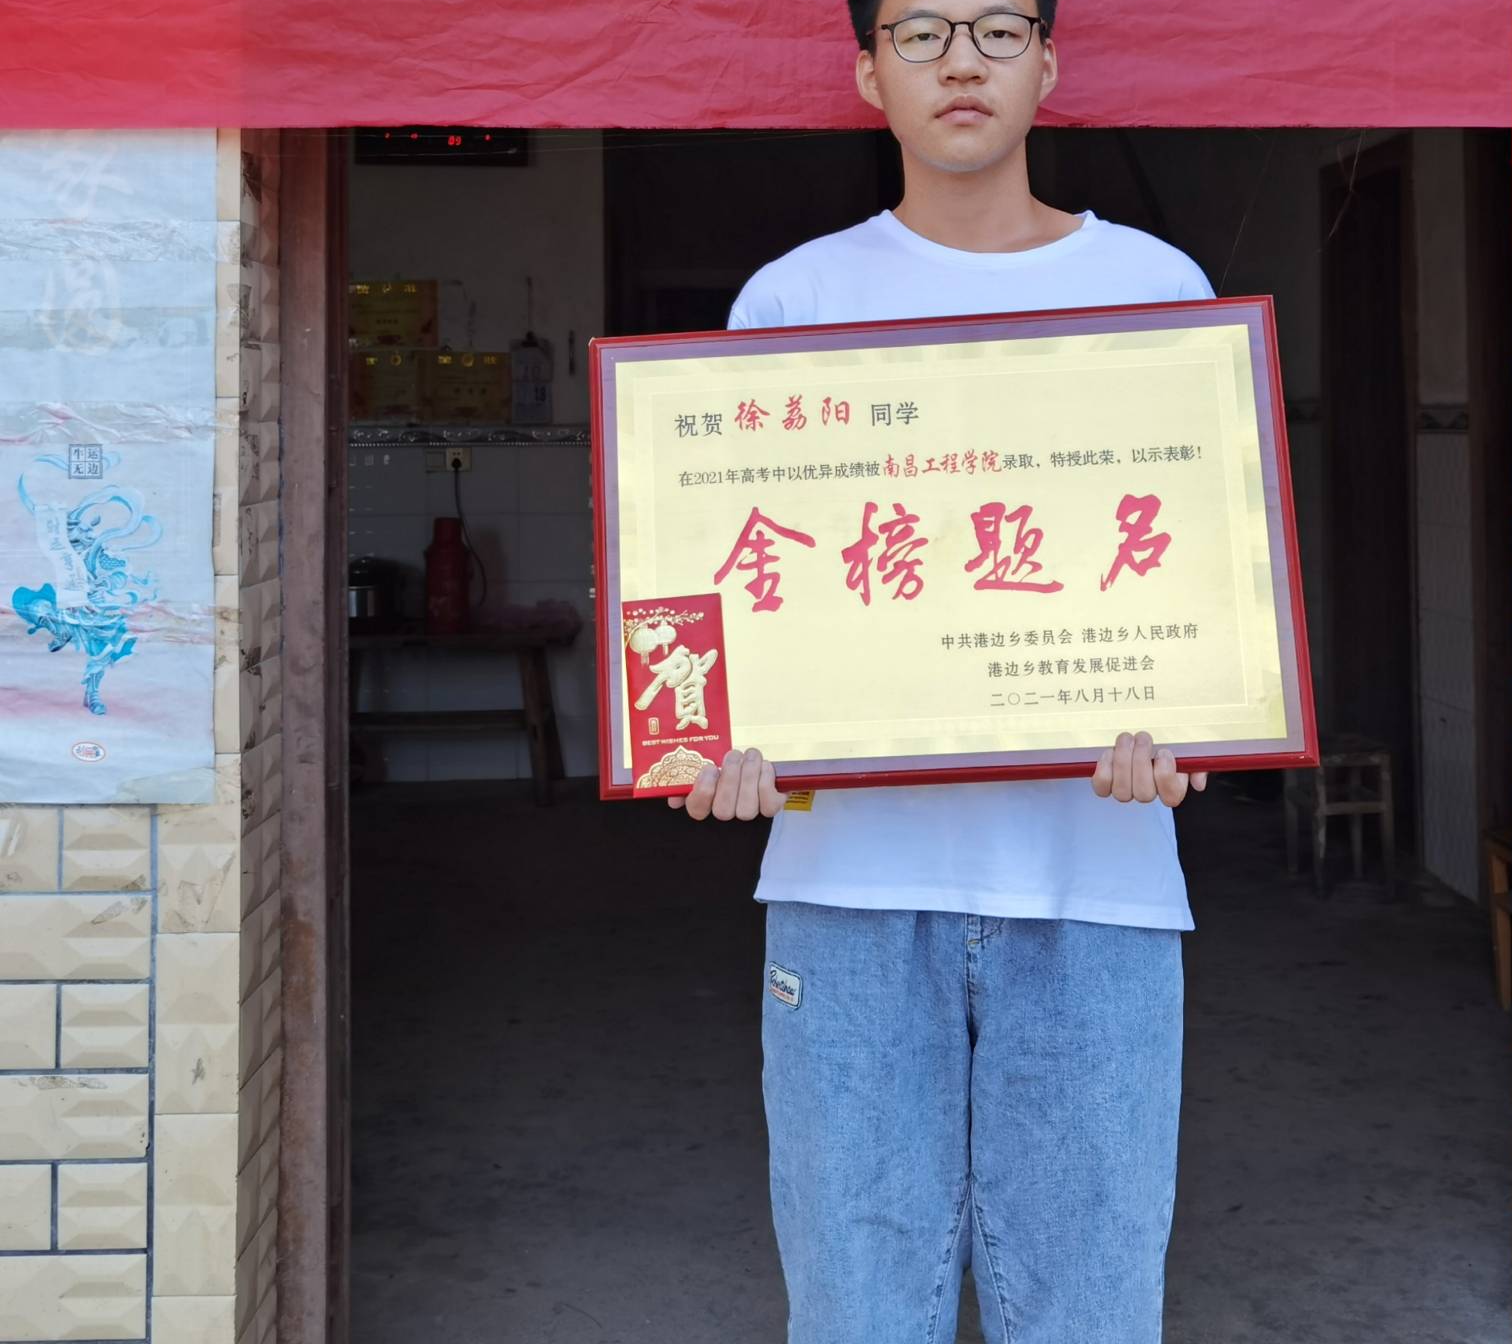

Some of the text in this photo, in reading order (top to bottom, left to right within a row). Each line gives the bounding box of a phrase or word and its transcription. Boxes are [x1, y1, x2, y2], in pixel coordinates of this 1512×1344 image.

[674, 395, 919, 438] 祝贺 徐荔阳 同学
[713, 493, 1172, 613] 金榜题名
[941, 623, 1199, 650] 中共港边乡委员会 港边乡人民政府
[988, 655, 1155, 678] 港边乡教育发展促进会
